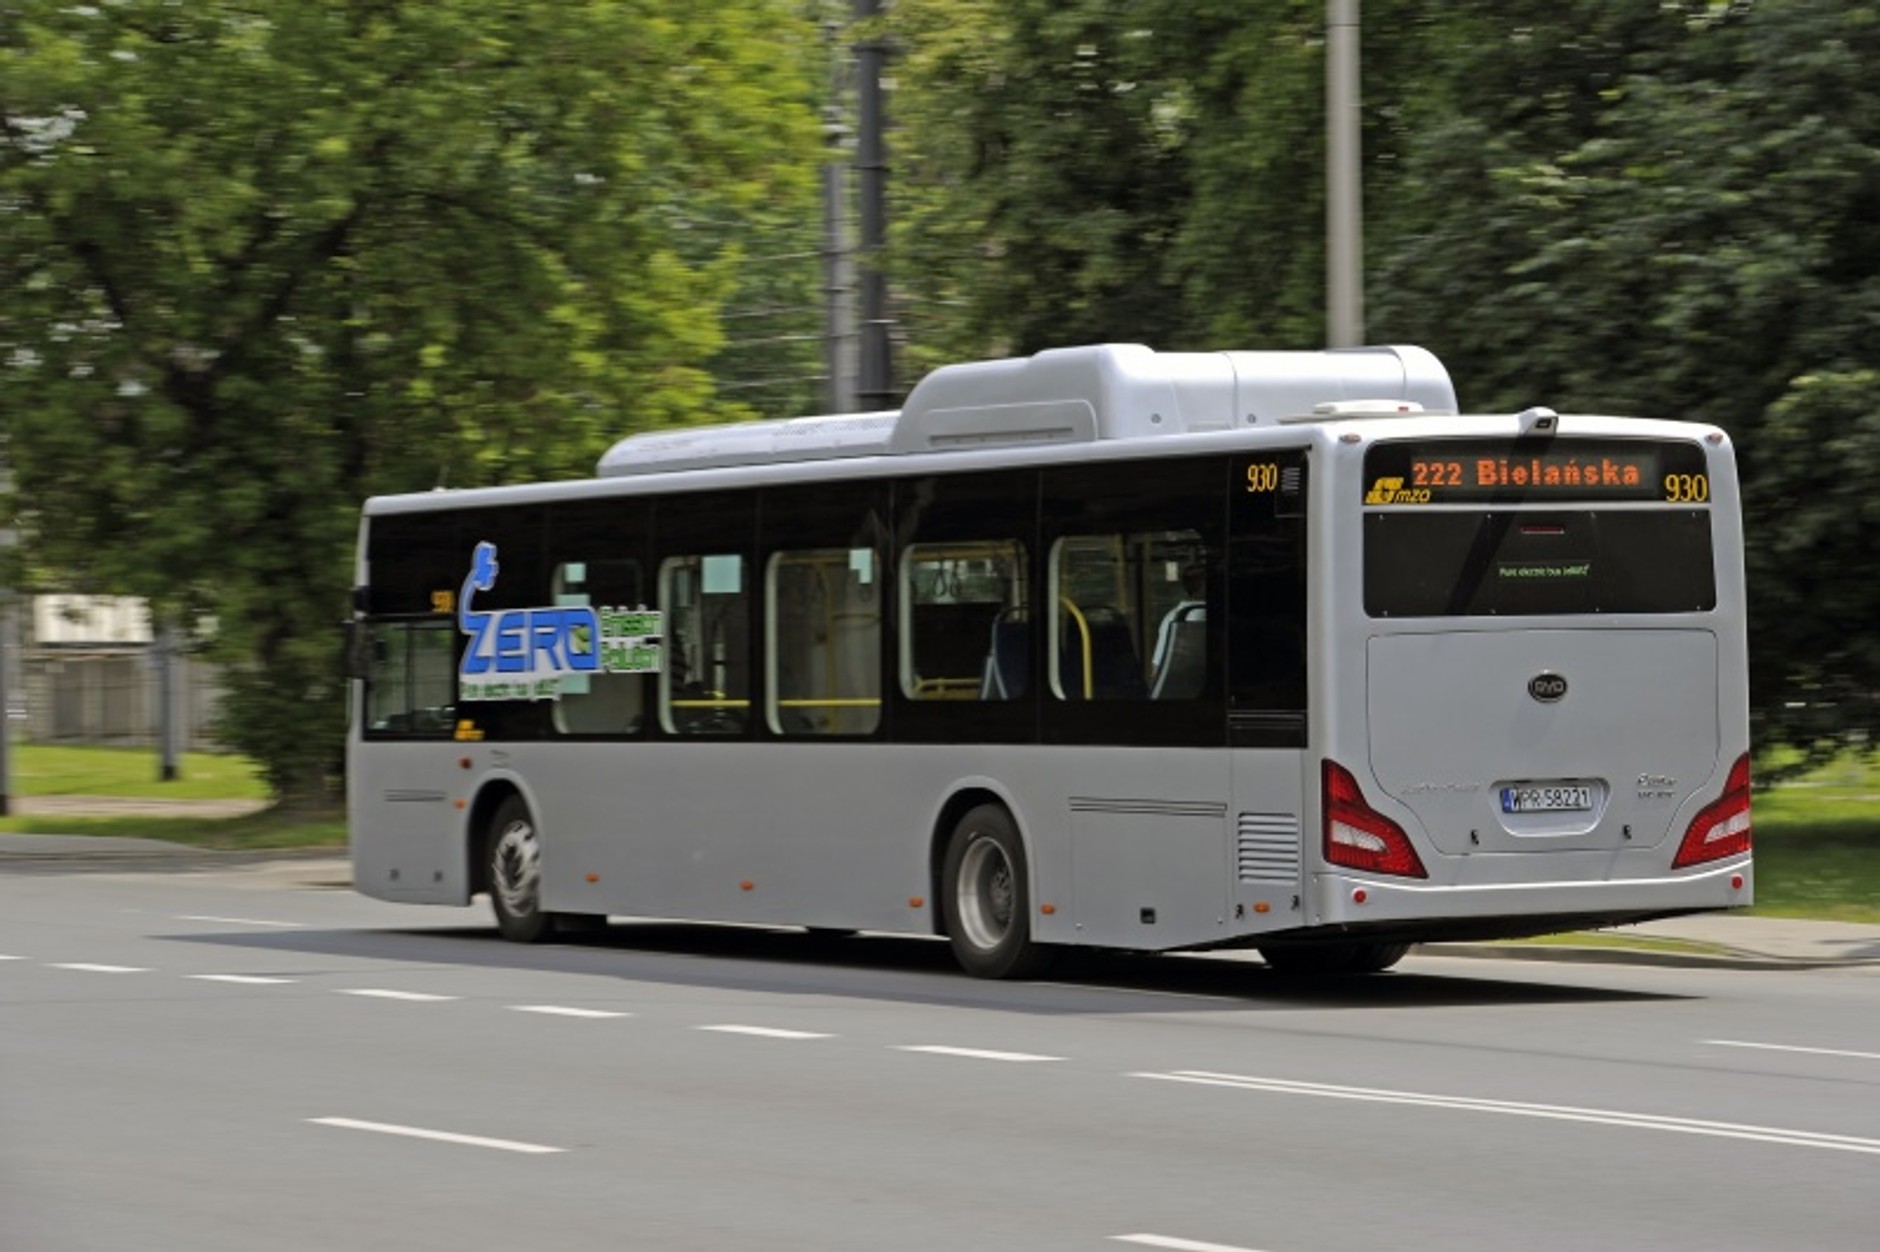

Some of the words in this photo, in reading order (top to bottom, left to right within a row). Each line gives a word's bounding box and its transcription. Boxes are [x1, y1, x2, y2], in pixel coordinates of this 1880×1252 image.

[1246, 463, 1278, 493] 930
[1412, 462, 1463, 486] 222
[1477, 457, 1639, 486] Bielańska
[1665, 474, 1708, 502] 930
[460, 607, 599, 674] ZERO
[1510, 788, 1541, 808] WPR
